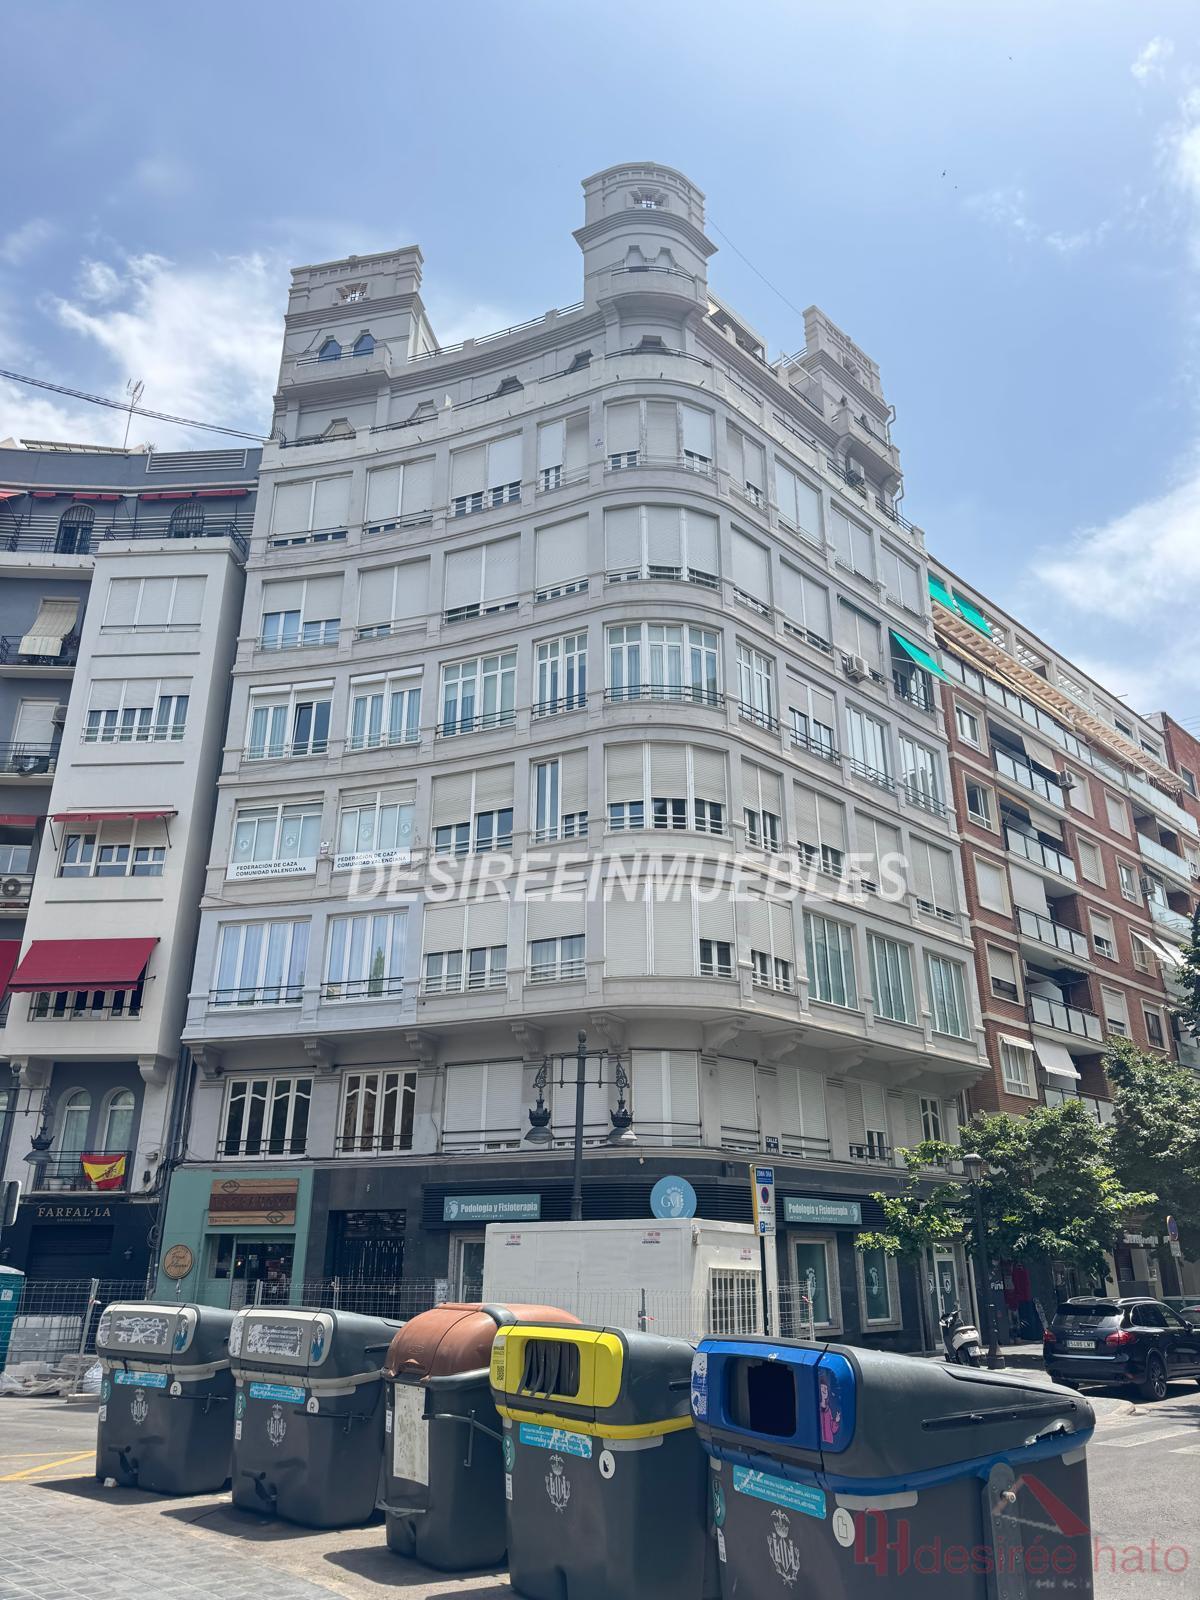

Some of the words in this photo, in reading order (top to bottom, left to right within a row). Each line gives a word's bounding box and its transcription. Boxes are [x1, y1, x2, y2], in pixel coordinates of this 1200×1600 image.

[235, 869, 270, 877] COMUNIDAD
[270, 866, 307, 874] VALENCIANA
[498, 1201, 538, 1212] Fisioterapia
[818, 1205, 848, 1216] Fisioterapia
